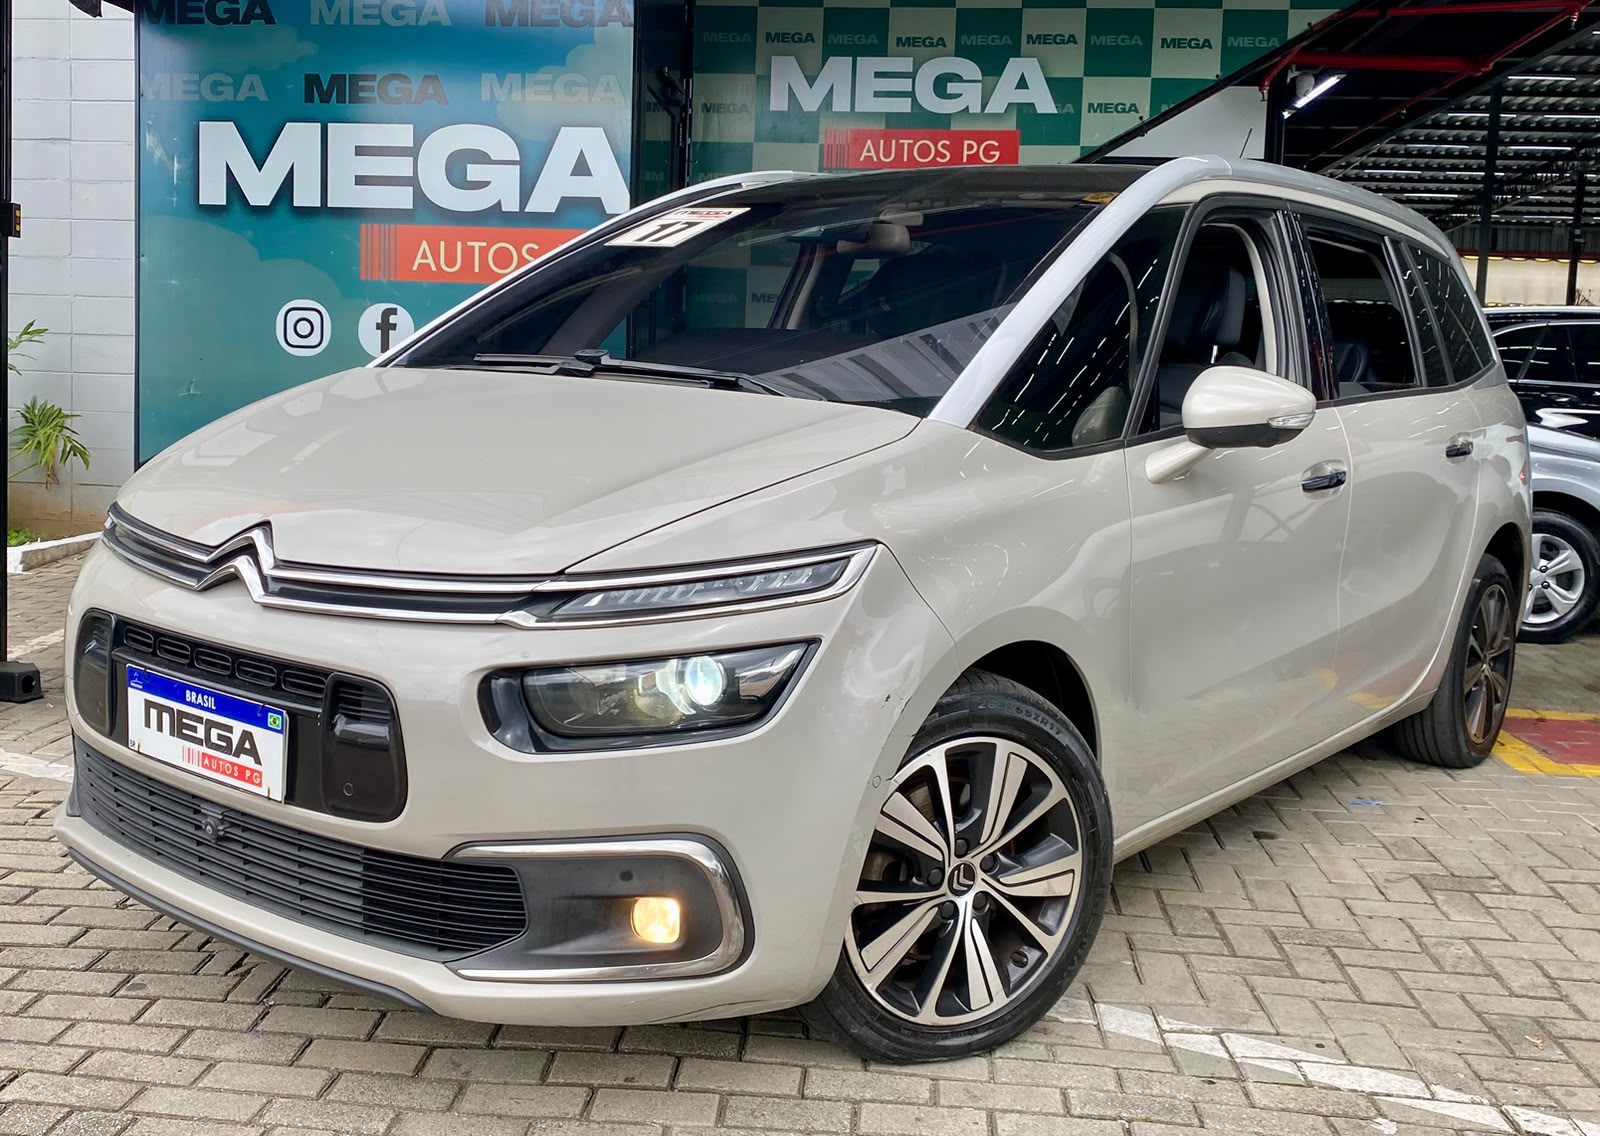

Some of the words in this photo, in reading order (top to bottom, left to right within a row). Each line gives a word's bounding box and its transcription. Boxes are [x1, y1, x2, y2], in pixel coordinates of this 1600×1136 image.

[140, 0, 277, 26] MEGA
[310, 0, 452, 27] MEGA
[485, 0, 634, 28] MEGA
[702, 31, 752, 44] MEGA
[765, 32, 815, 44] MEGA
[827, 33, 879, 46] MEGA
[895, 36, 947, 48] MEGA
[960, 34, 1012, 46] MEGA
[1026, 33, 1078, 46] MEGA
[1090, 34, 1143, 47] MEGA
[1161, 37, 1213, 50] MEGA
[1227, 36, 1280, 48] MEGA
[140, 72, 269, 102] MEGA
[304, 73, 448, 105] MEGA
[480, 73, 626, 104] MEGA
[769, 55, 1058, 114] MEGA
[701, 102, 750, 115] MEGA
[1087, 102, 1139, 114] MEGA
[860, 139, 951, 163] AUTOS
[962, 140, 1000, 164] PG
[199, 121, 631, 214] MEGA
[412, 239, 539, 275] AUTOS
[185, 689, 216, 710] BRASIL
[203, 757, 239, 777] AUTOS
[245, 770, 261, 785] PG
